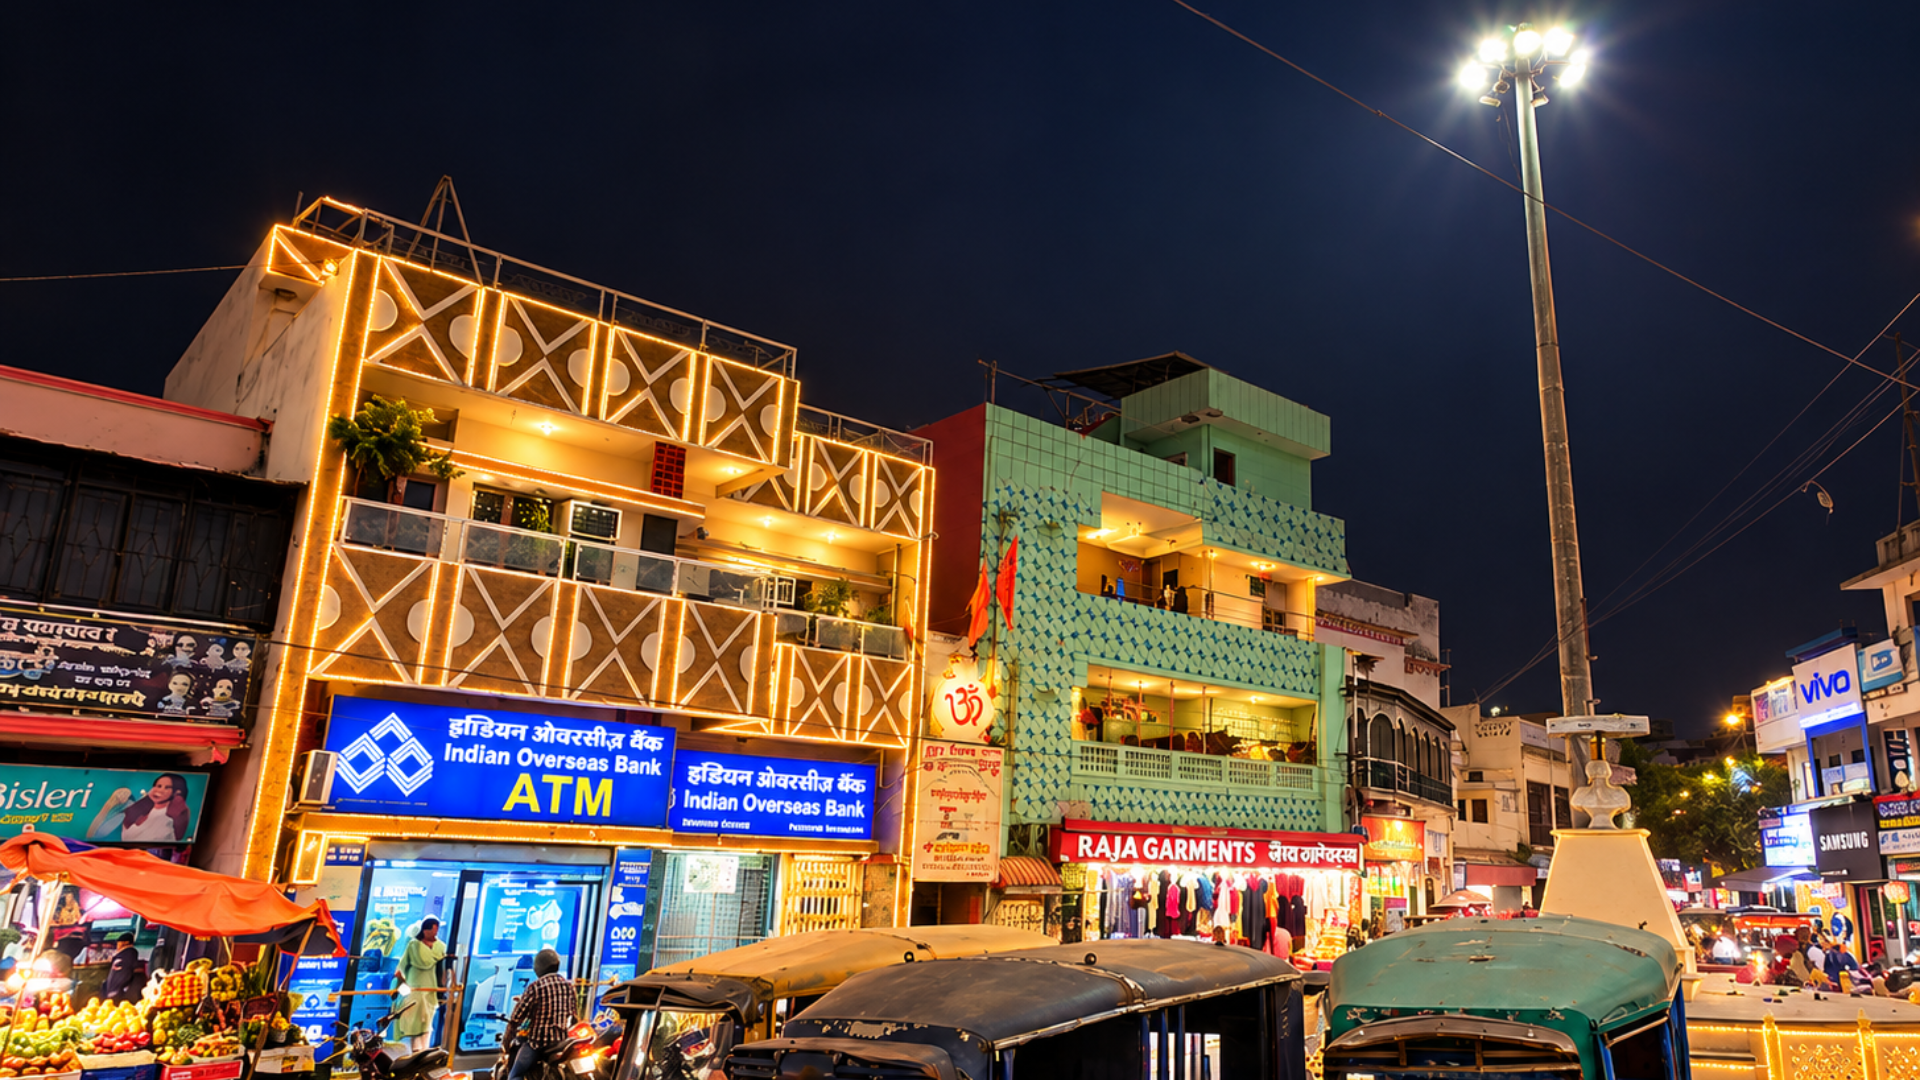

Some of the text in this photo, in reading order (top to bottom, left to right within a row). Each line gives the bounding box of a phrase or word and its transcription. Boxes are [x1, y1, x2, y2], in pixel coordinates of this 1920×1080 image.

[444, 743, 662, 776] Indian Overseas Bank
[502, 773, 613, 817] ATM
[683, 790, 865, 818] Indian Overseas Bank
[1078, 835, 1256, 864] RAJA GARMENTS
[1819, 831, 1869, 851] SAMSUNG
